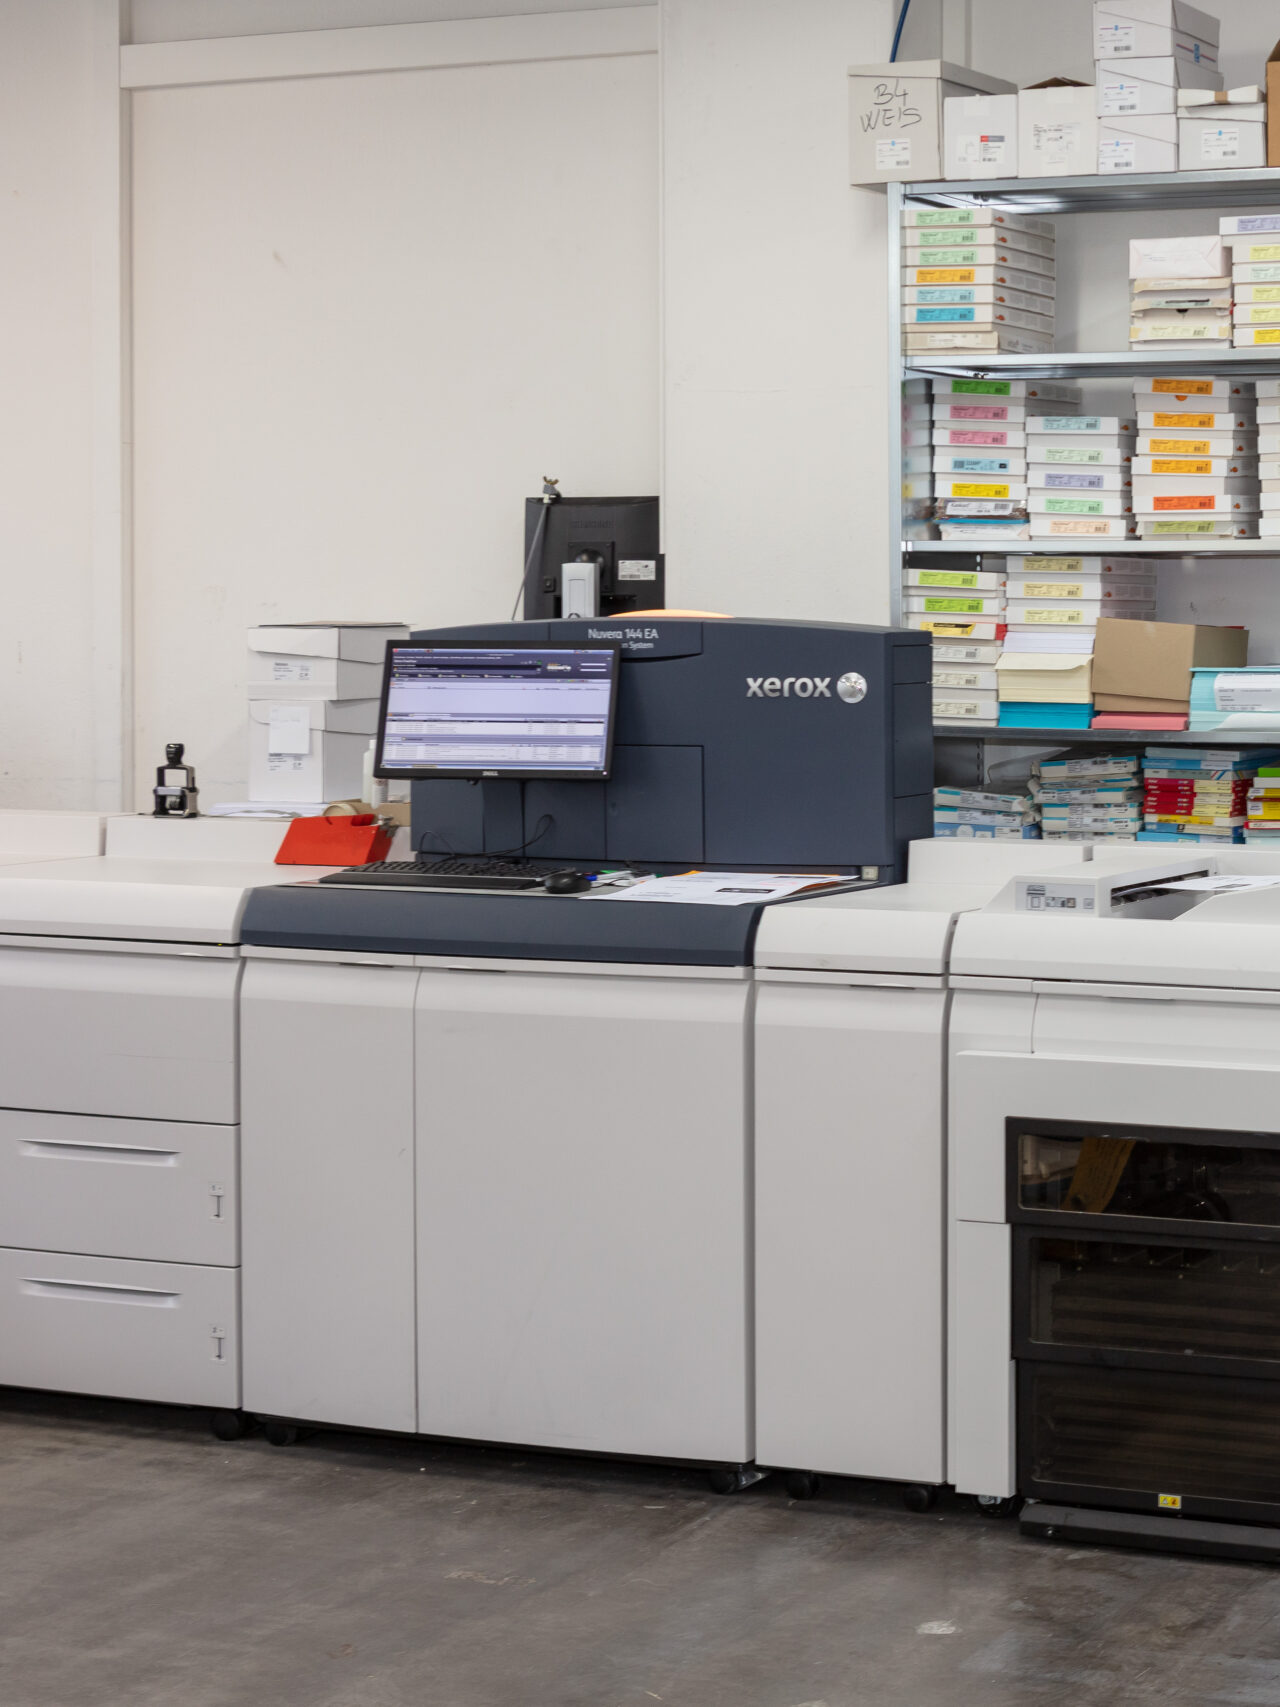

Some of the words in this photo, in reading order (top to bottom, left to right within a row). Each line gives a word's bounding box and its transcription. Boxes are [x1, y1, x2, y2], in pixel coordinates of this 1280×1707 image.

[873, 78, 909, 106] B4
[587, 628, 623, 639] Nuvera
[624, 628, 643, 639] 144
[644, 628, 660, 639] EA
[628, 641, 655, 651] System
[746, 677, 832, 698] xerox
